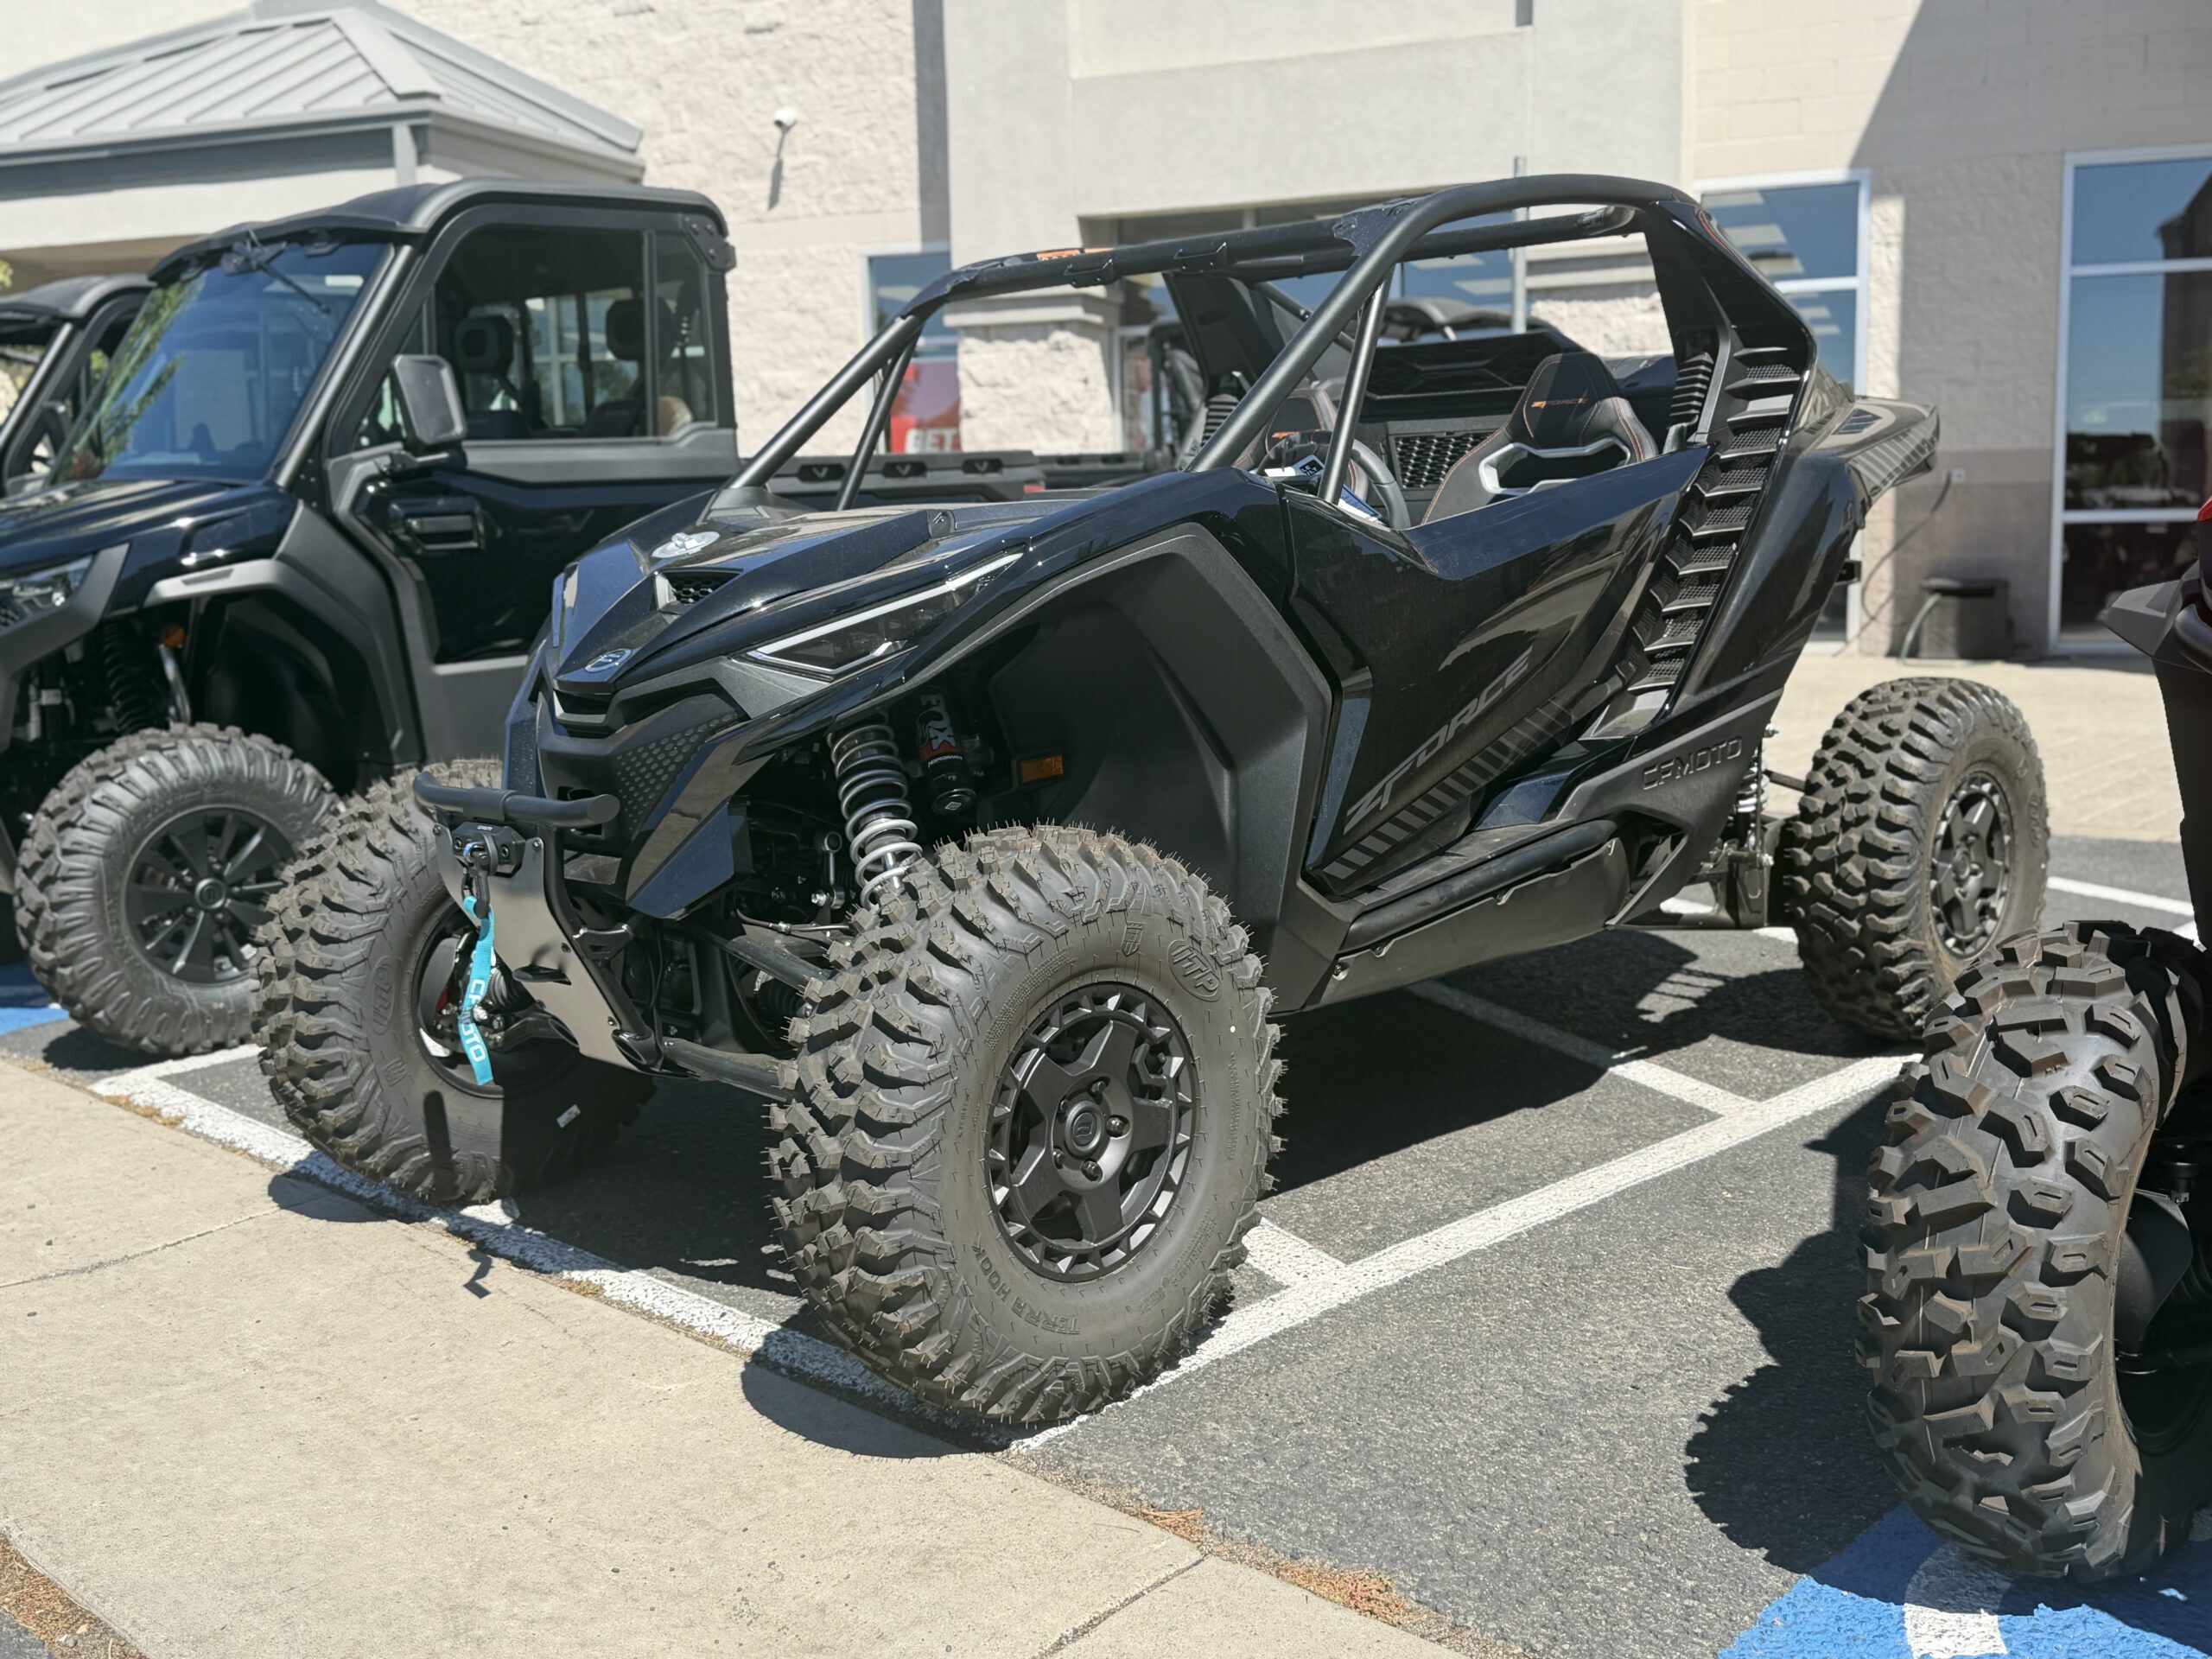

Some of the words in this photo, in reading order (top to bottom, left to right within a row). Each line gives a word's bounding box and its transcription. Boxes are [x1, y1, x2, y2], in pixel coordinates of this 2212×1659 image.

[918, 692, 957, 751] FOX
[1344, 645, 1533, 835] ZFORCE
[1643, 737, 1743, 790] CFMOTO
[1171, 945, 1221, 992] ITP
